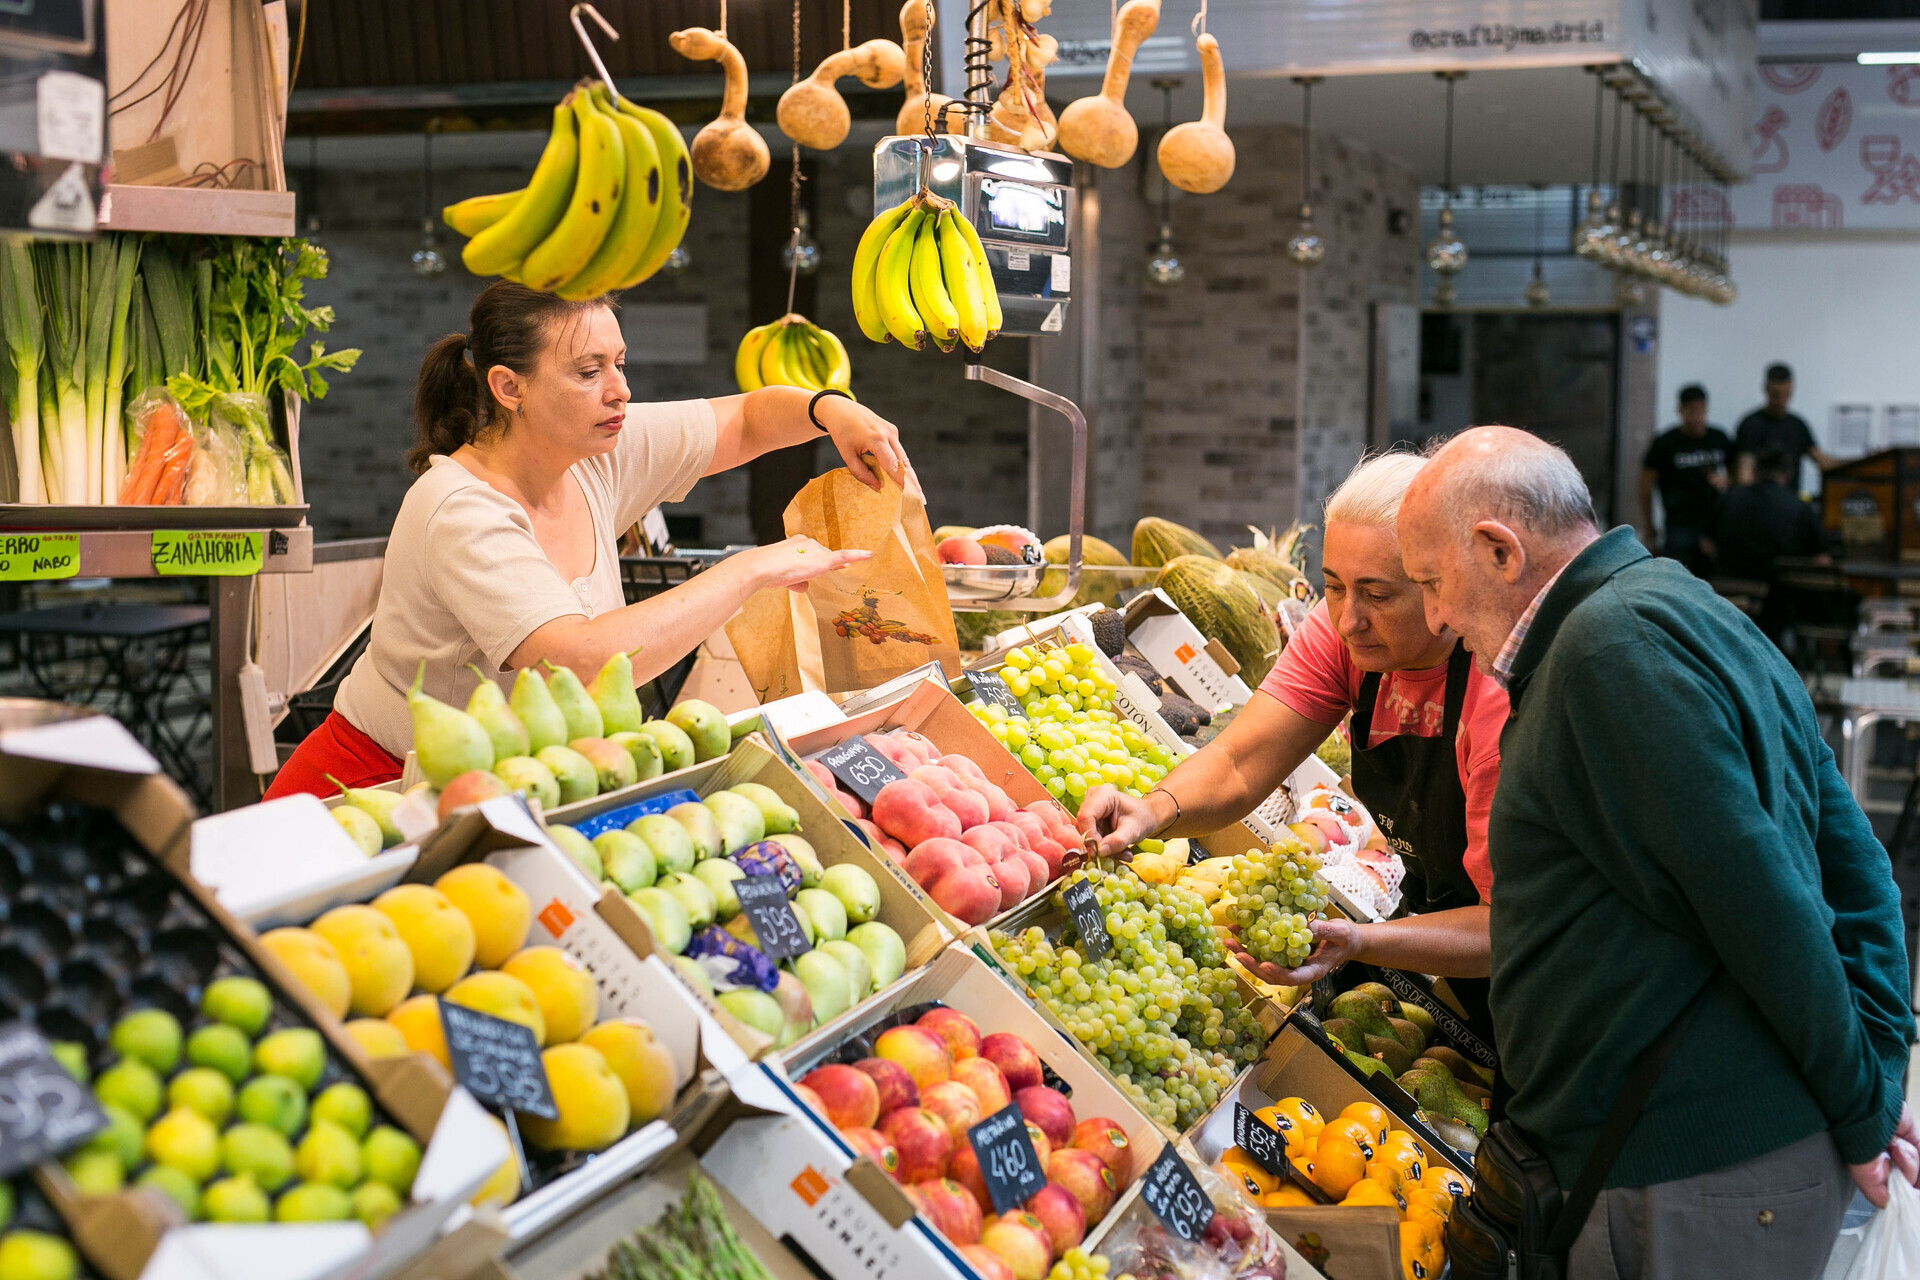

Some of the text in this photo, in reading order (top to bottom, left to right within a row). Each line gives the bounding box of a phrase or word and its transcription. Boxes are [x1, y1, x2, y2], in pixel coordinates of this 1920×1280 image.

[33, 555, 71, 573] NABO
[152, 536, 256, 566] ZANAHORIA
[1114, 689, 1153, 733] COTÓN
[849, 755, 886, 785] 6'50
[1380, 966, 1498, 1068] PERAS DE RINCÓN DE SOTO
[1169, 1181, 1203, 1240] 6'95
